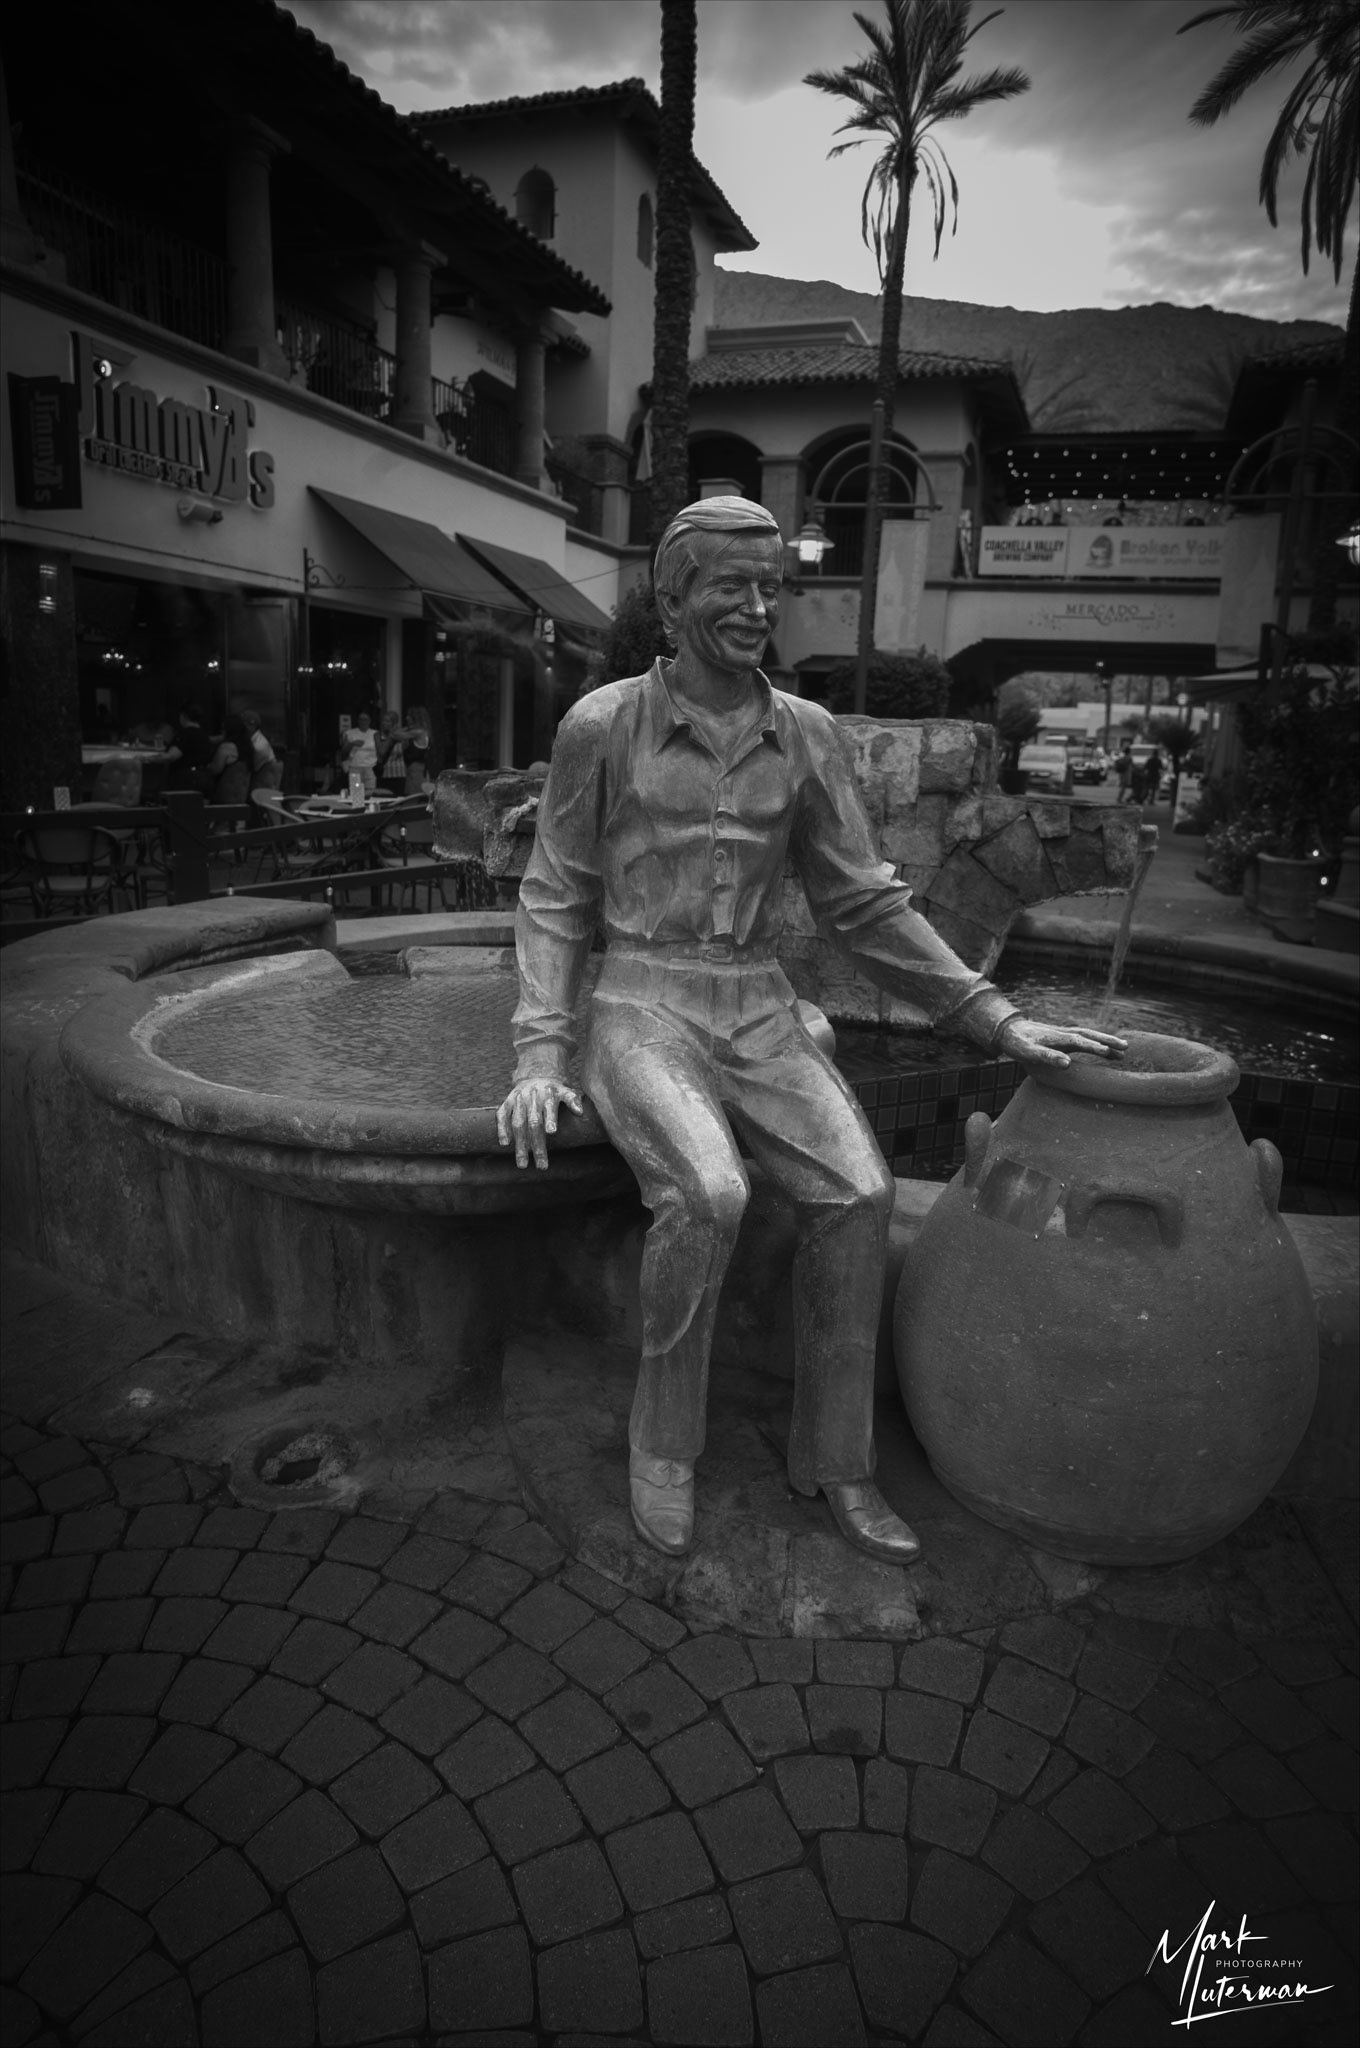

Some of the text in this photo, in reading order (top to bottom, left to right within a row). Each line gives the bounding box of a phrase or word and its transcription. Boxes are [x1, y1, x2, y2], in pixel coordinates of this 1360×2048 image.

[985, 540, 1064, 552] COACHELLA VALLEY
[1120, 539, 1180, 555] Broken
[1065, 604, 1140, 617] MERCADO
